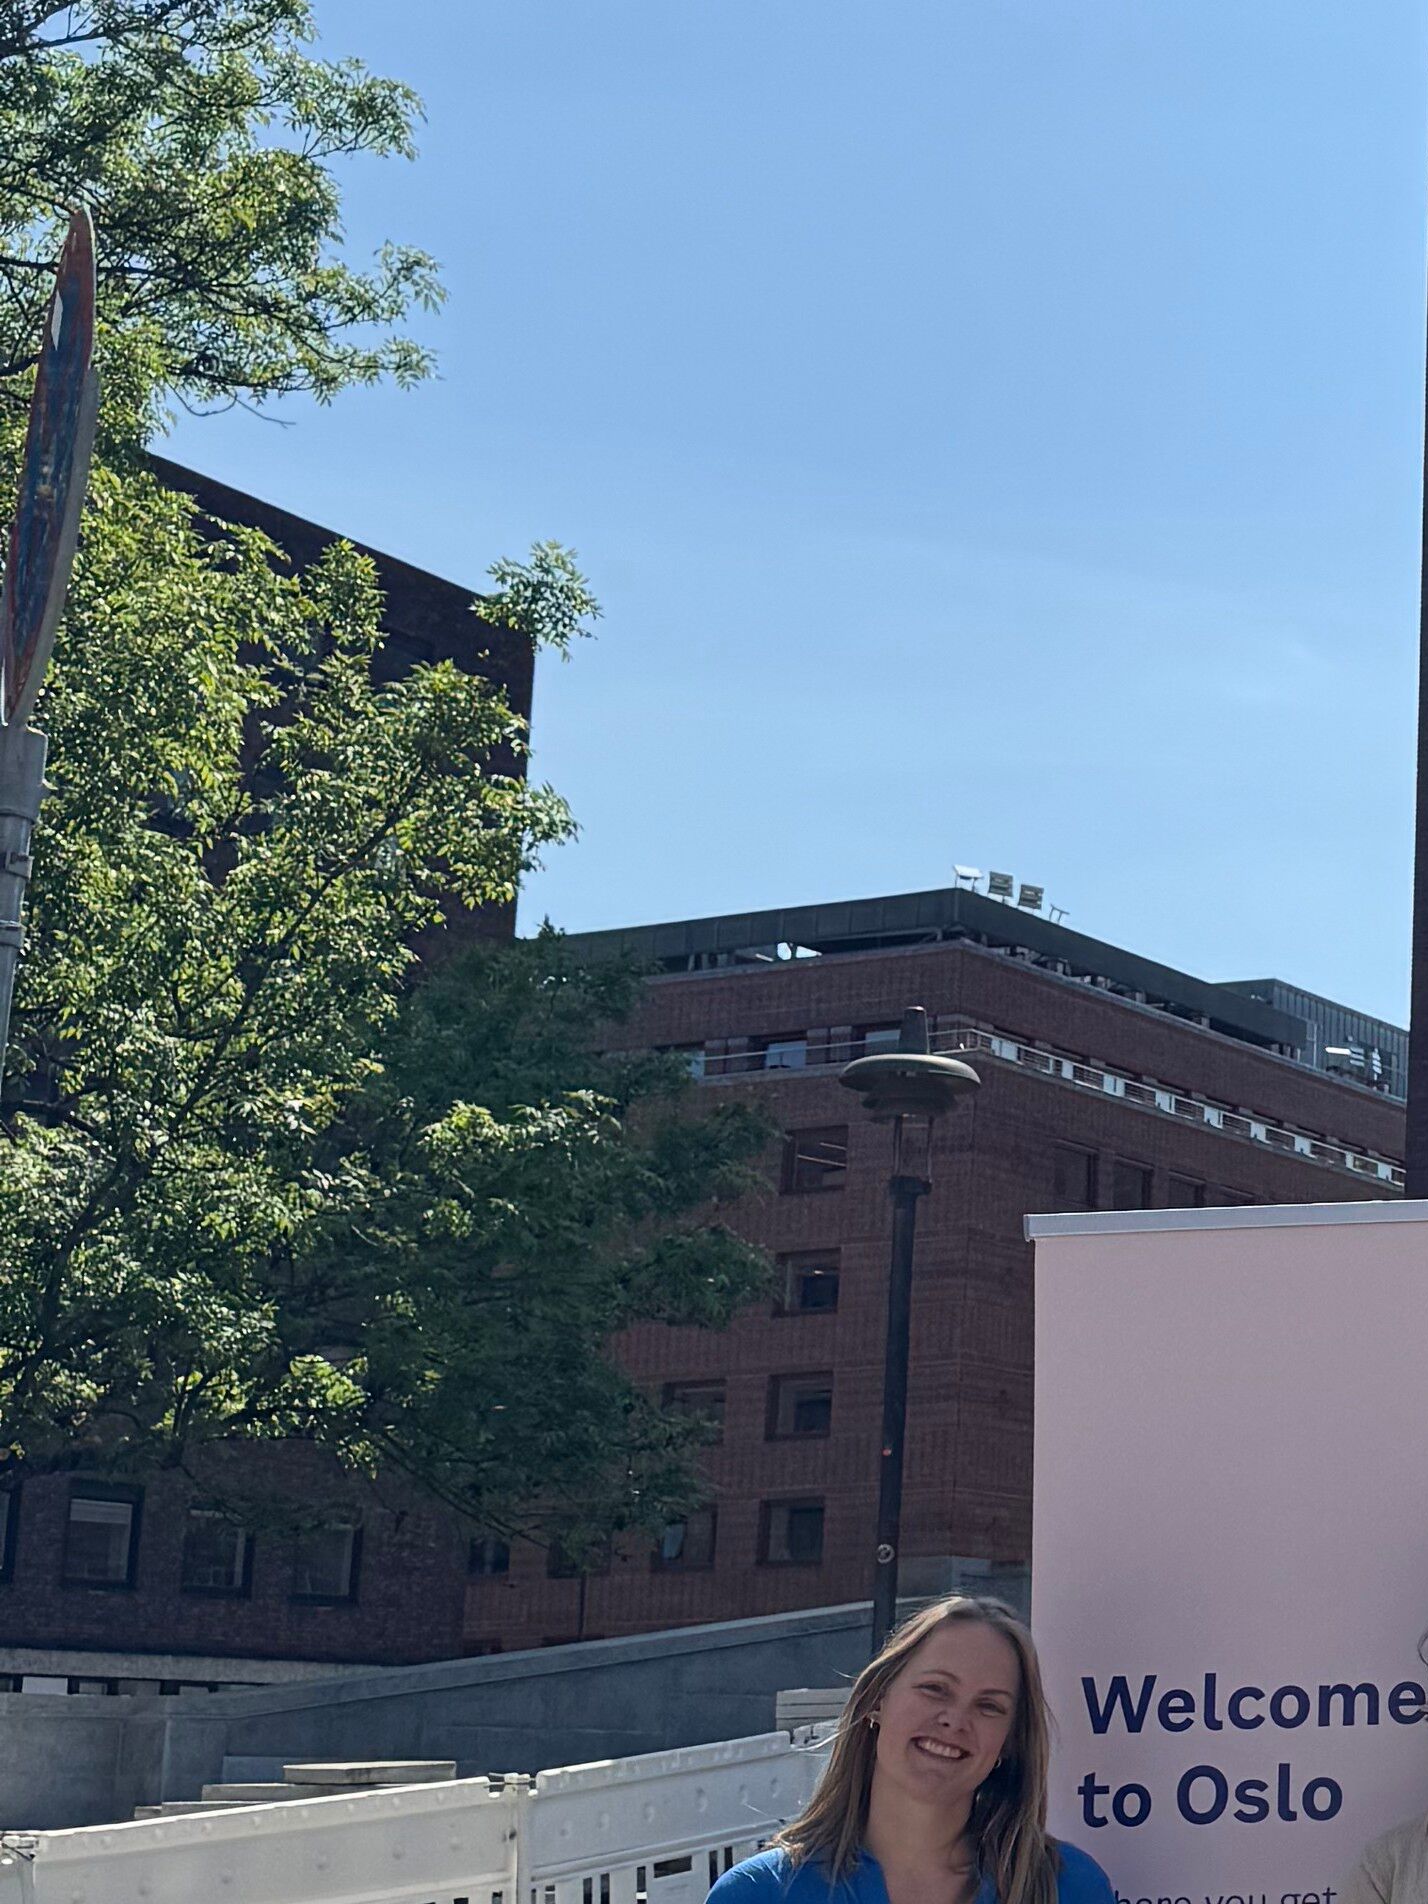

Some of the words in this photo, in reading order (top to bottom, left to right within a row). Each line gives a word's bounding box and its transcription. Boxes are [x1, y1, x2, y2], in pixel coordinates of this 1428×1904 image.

[1080, 1672, 1427, 1735] Welcome
[1077, 1771, 1153, 1829] to
[1175, 1762, 1344, 1826] Oslo
